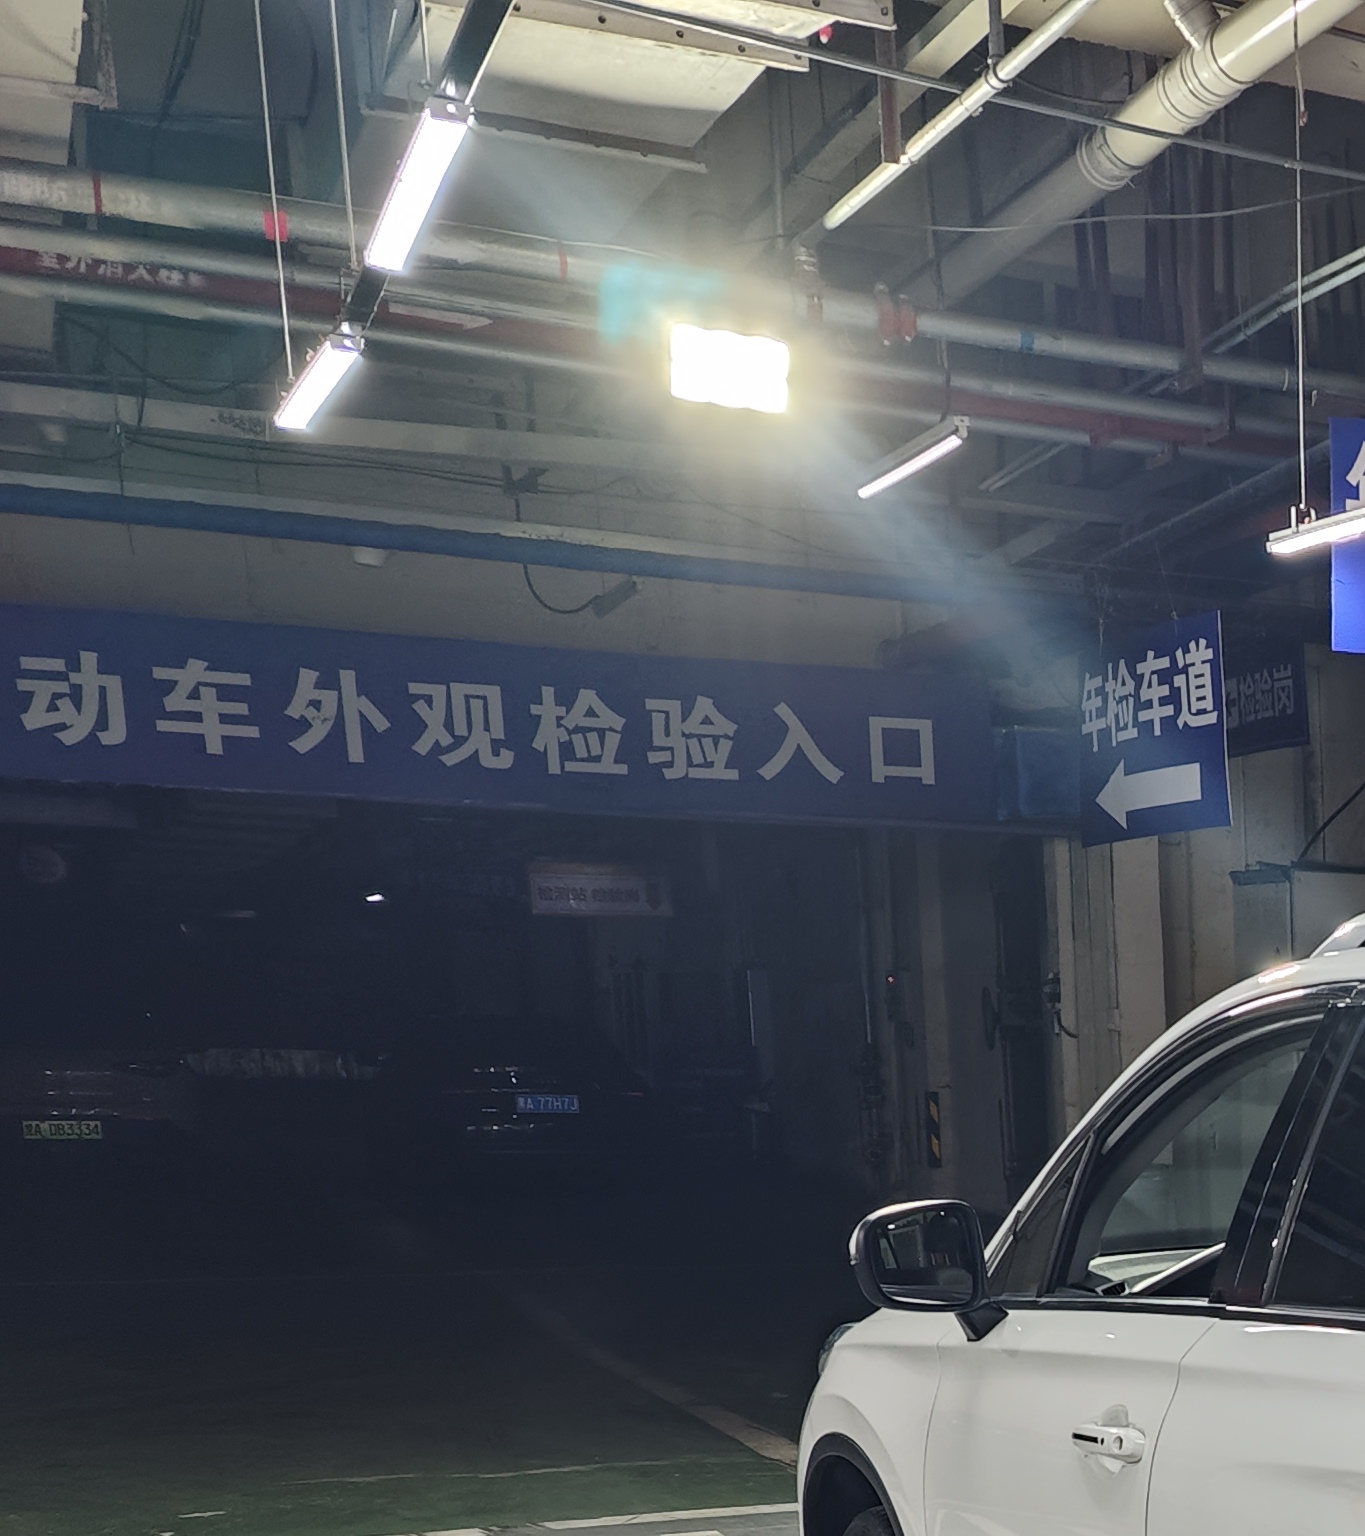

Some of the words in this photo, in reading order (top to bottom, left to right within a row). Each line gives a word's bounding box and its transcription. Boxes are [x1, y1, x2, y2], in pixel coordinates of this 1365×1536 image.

[16, 650, 936, 786] 动车外观检验入口
[1081, 638, 1218, 753] 年检车道
